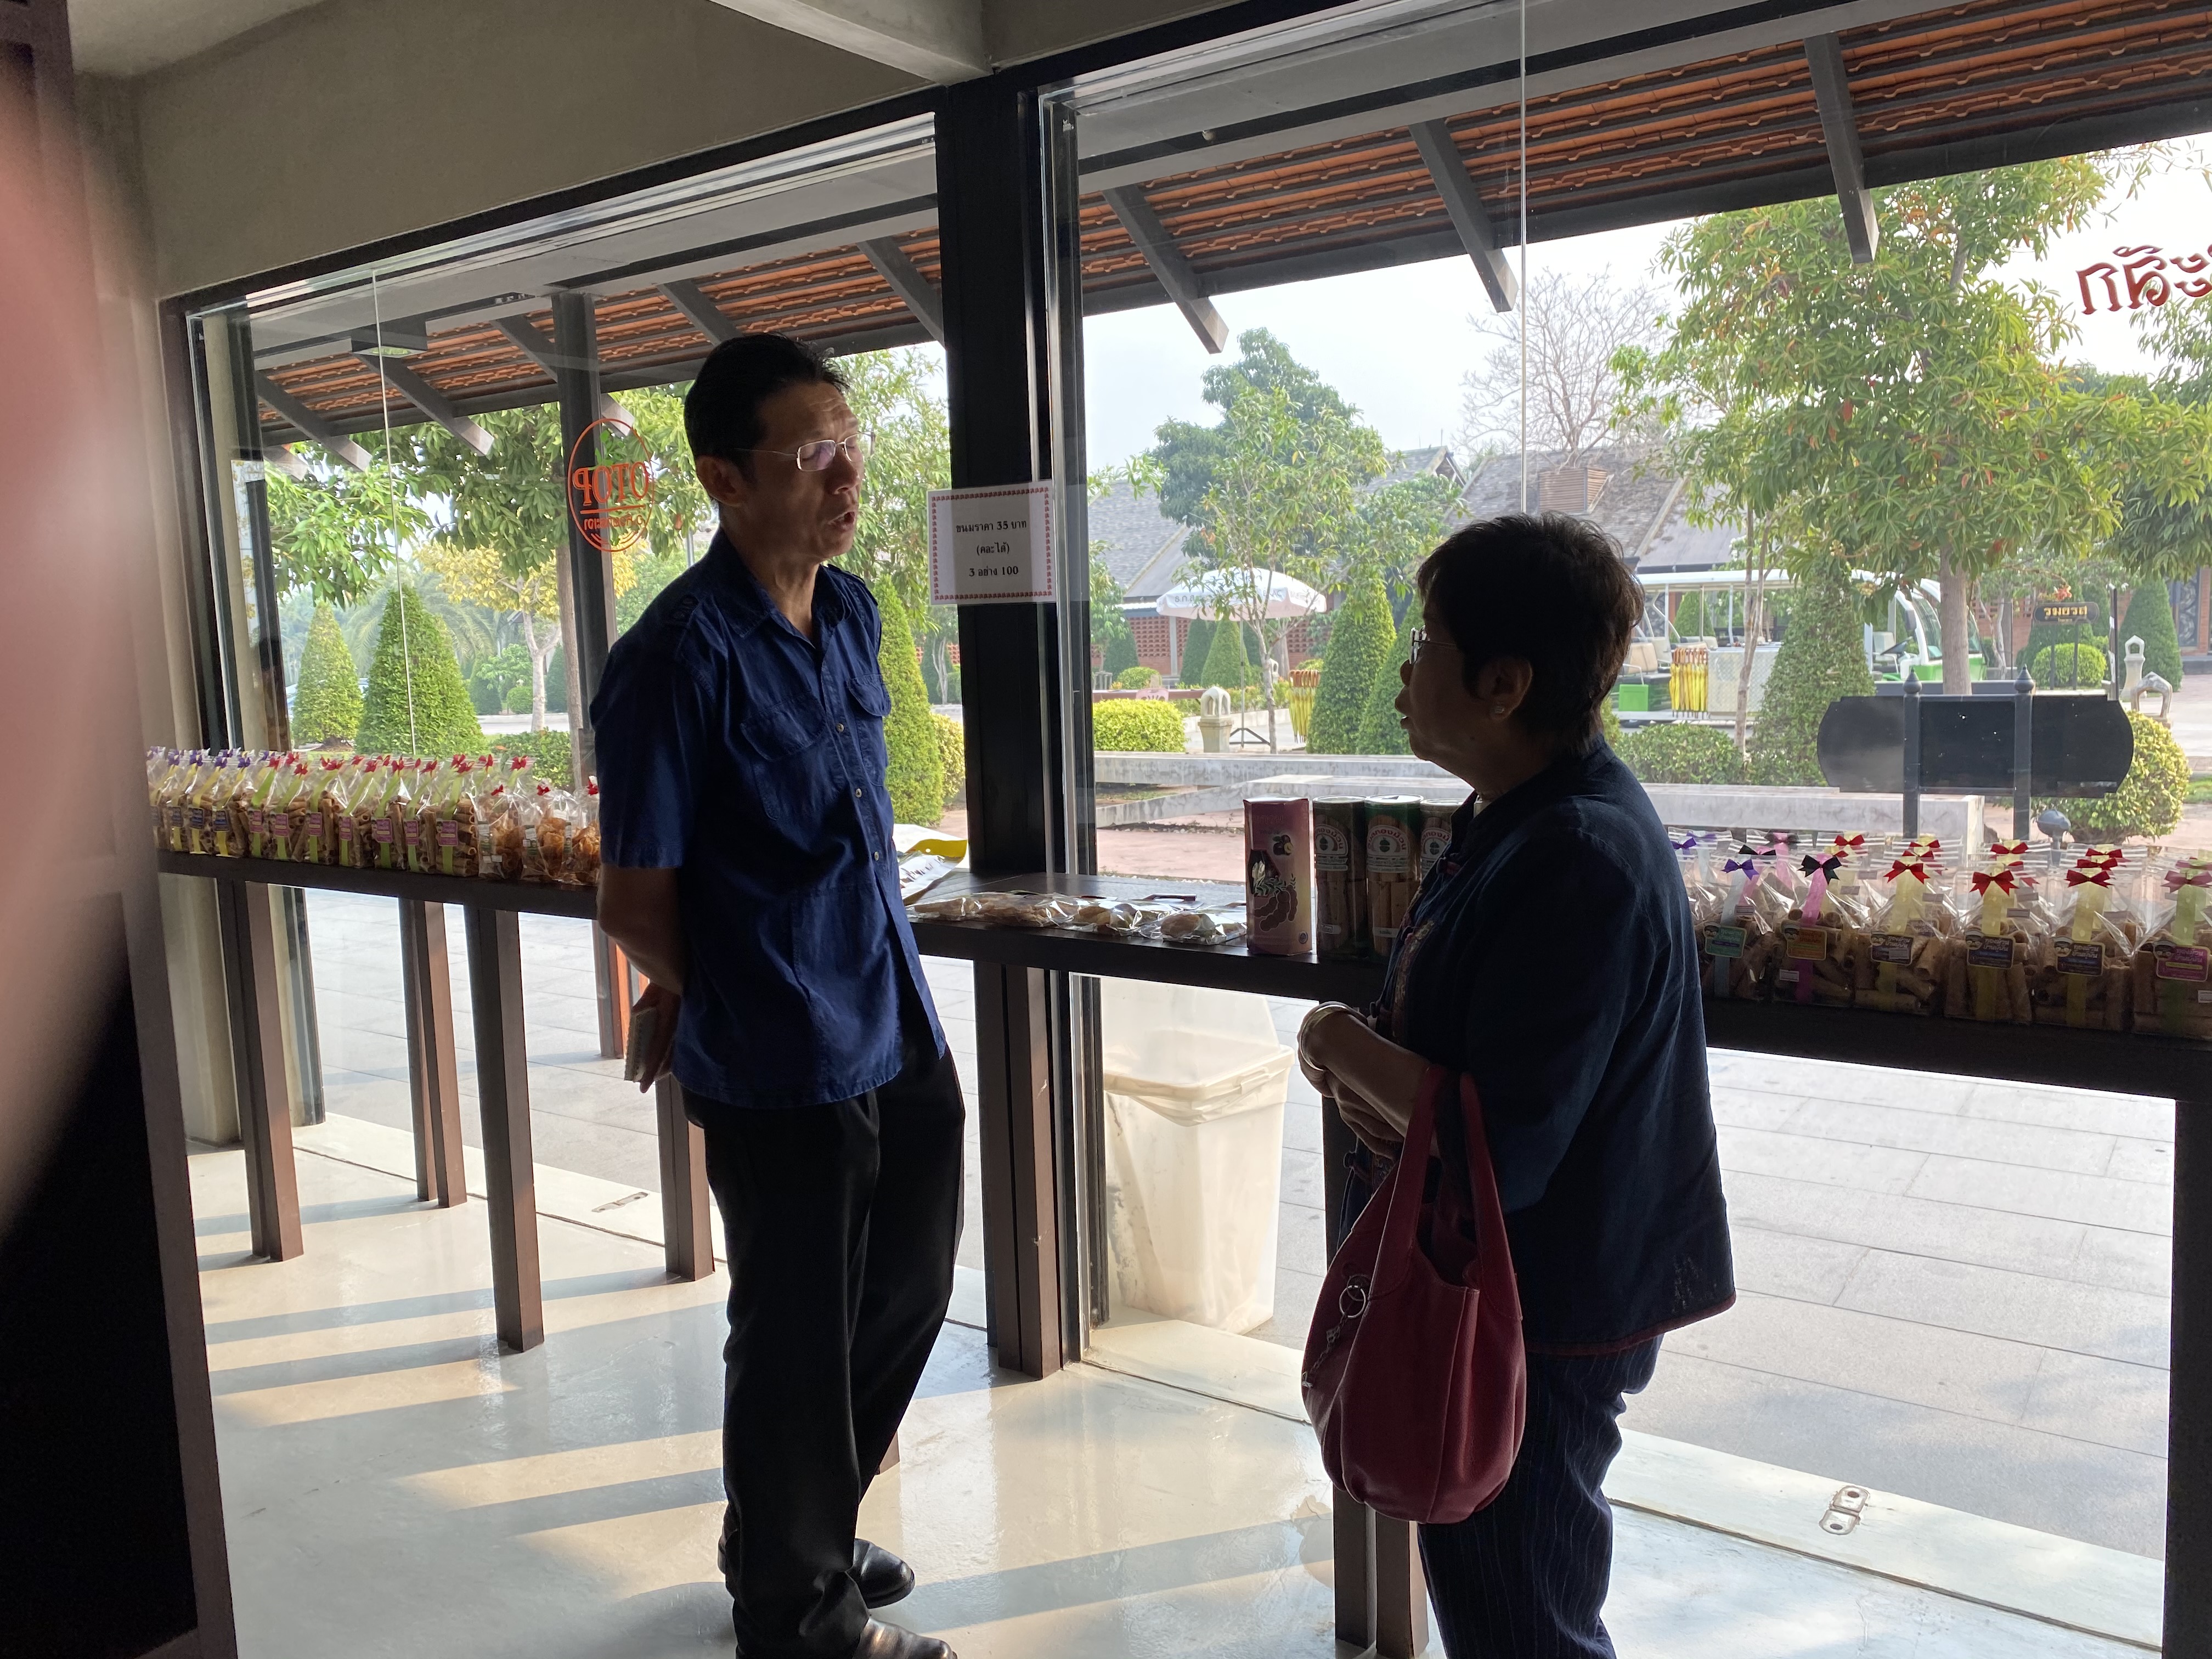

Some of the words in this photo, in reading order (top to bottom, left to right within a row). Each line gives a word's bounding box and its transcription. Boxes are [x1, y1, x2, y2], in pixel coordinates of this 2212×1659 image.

[956, 523, 994, 533] ขนมราคา
[997, 521, 1008, 531] 35
[1011, 520, 1027, 529] บาท
[976, 541, 1010, 556] (คละได้)
[969, 568, 975, 577] 3
[978, 566, 997, 577] อย่าง
[1002, 566, 1019, 575] 100
